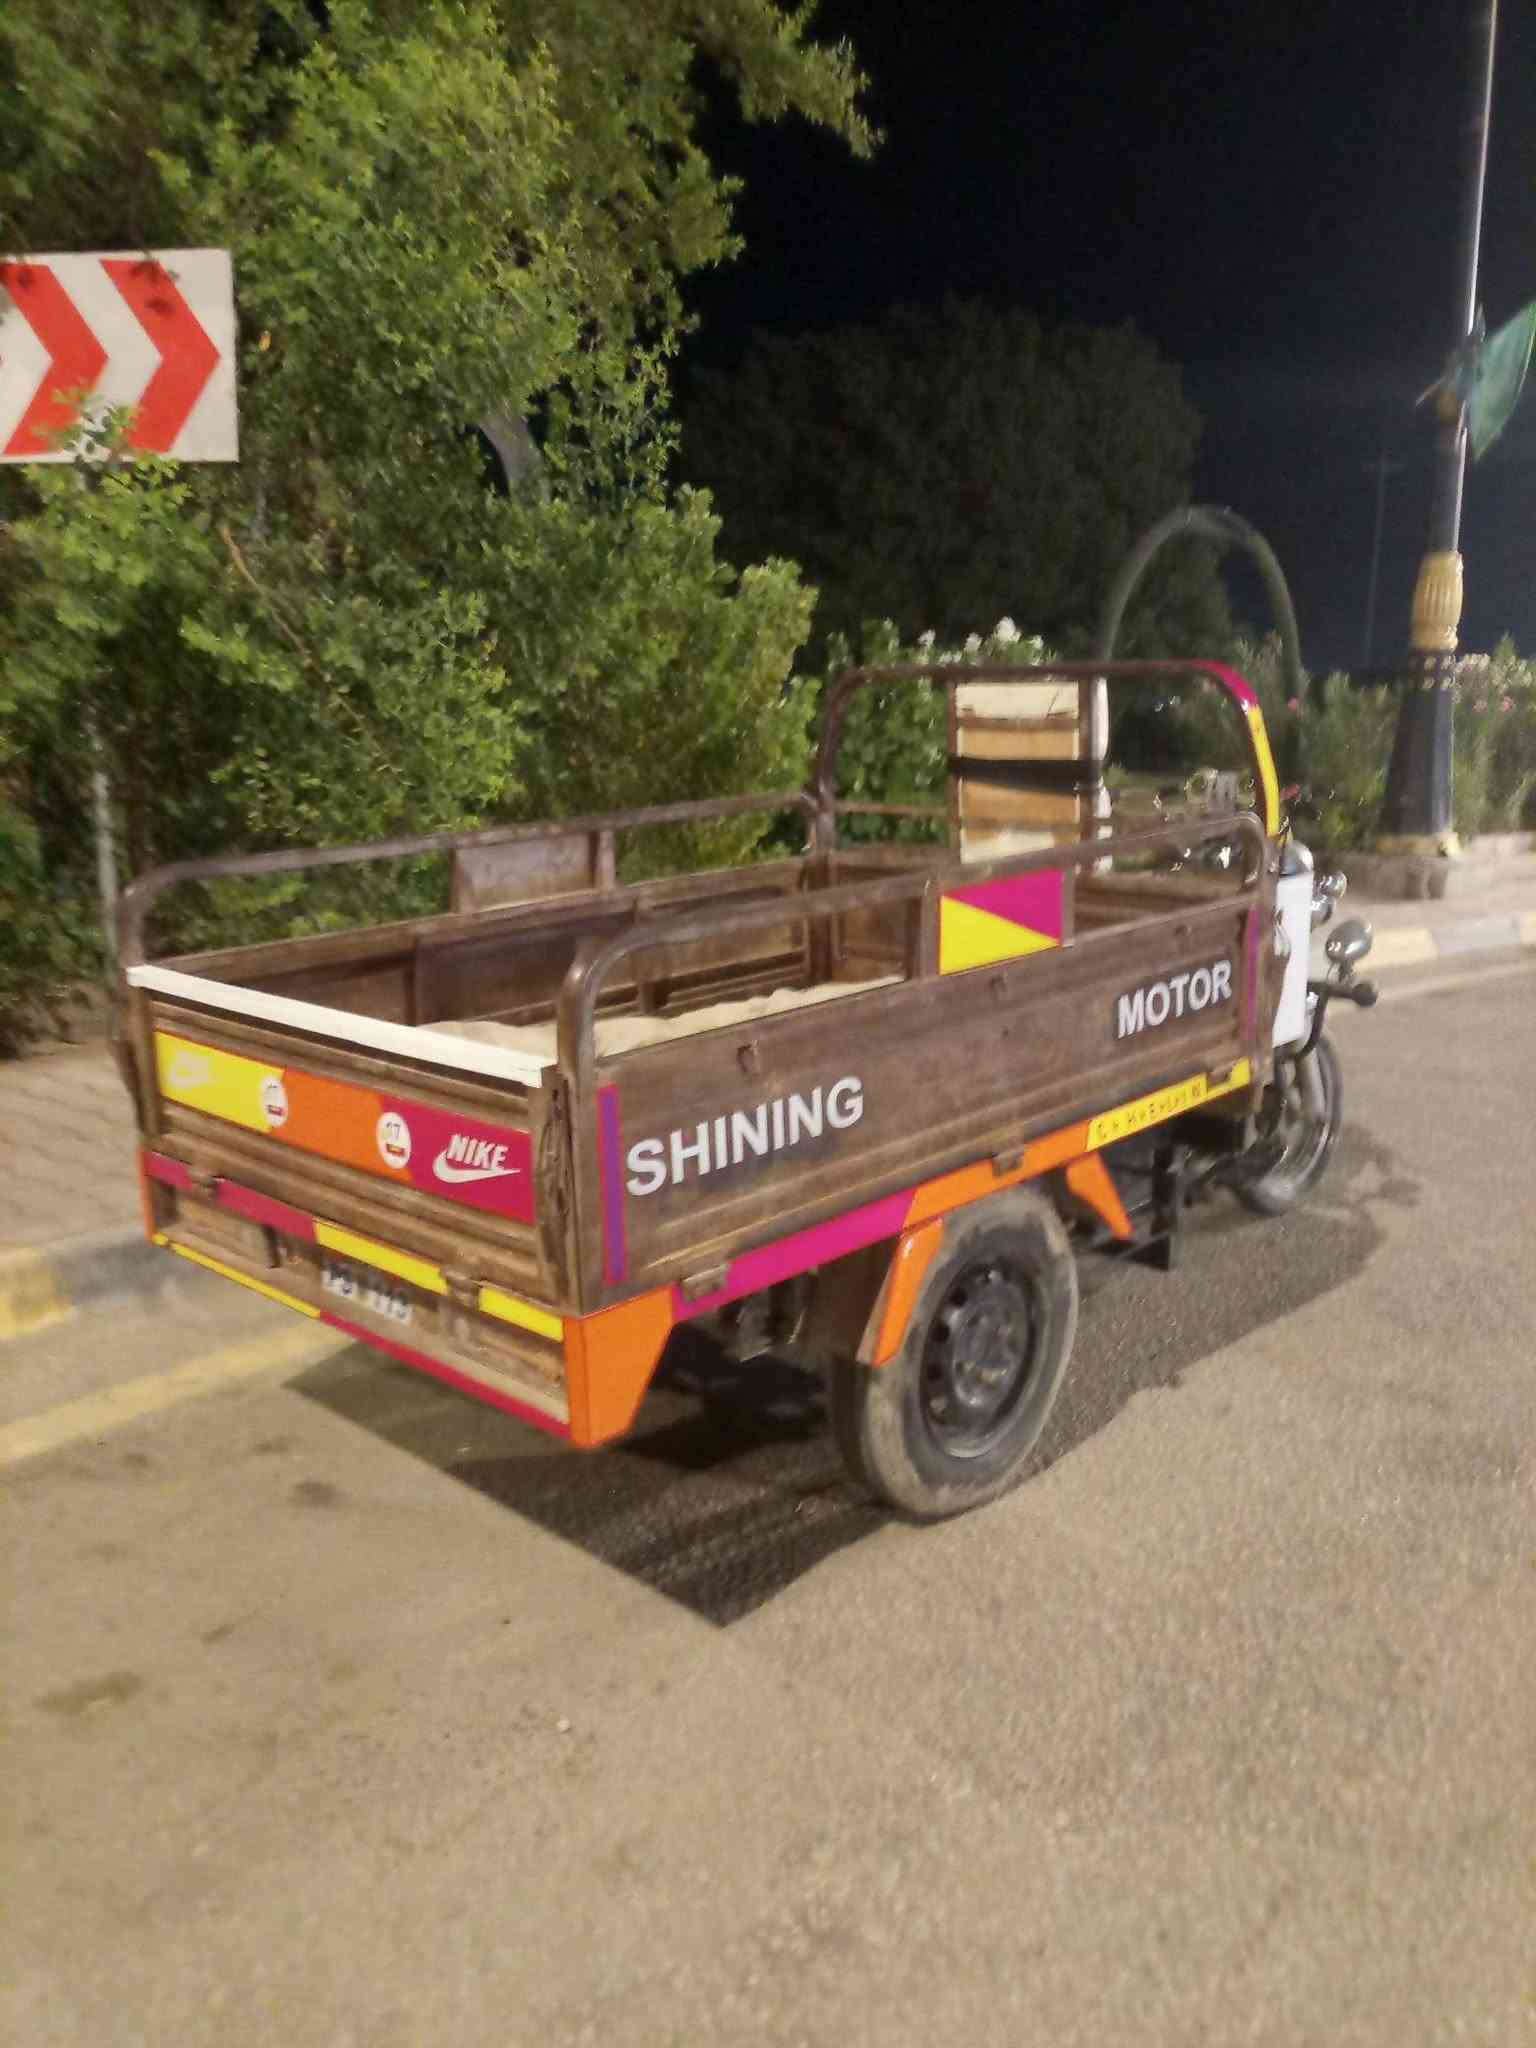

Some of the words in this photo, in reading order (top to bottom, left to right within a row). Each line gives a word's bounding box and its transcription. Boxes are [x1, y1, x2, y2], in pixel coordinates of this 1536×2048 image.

[1118, 959, 1232, 1039] MOTOR
[446, 1134, 509, 1171] NIKE
[626, 1076, 864, 1196] SHINING
